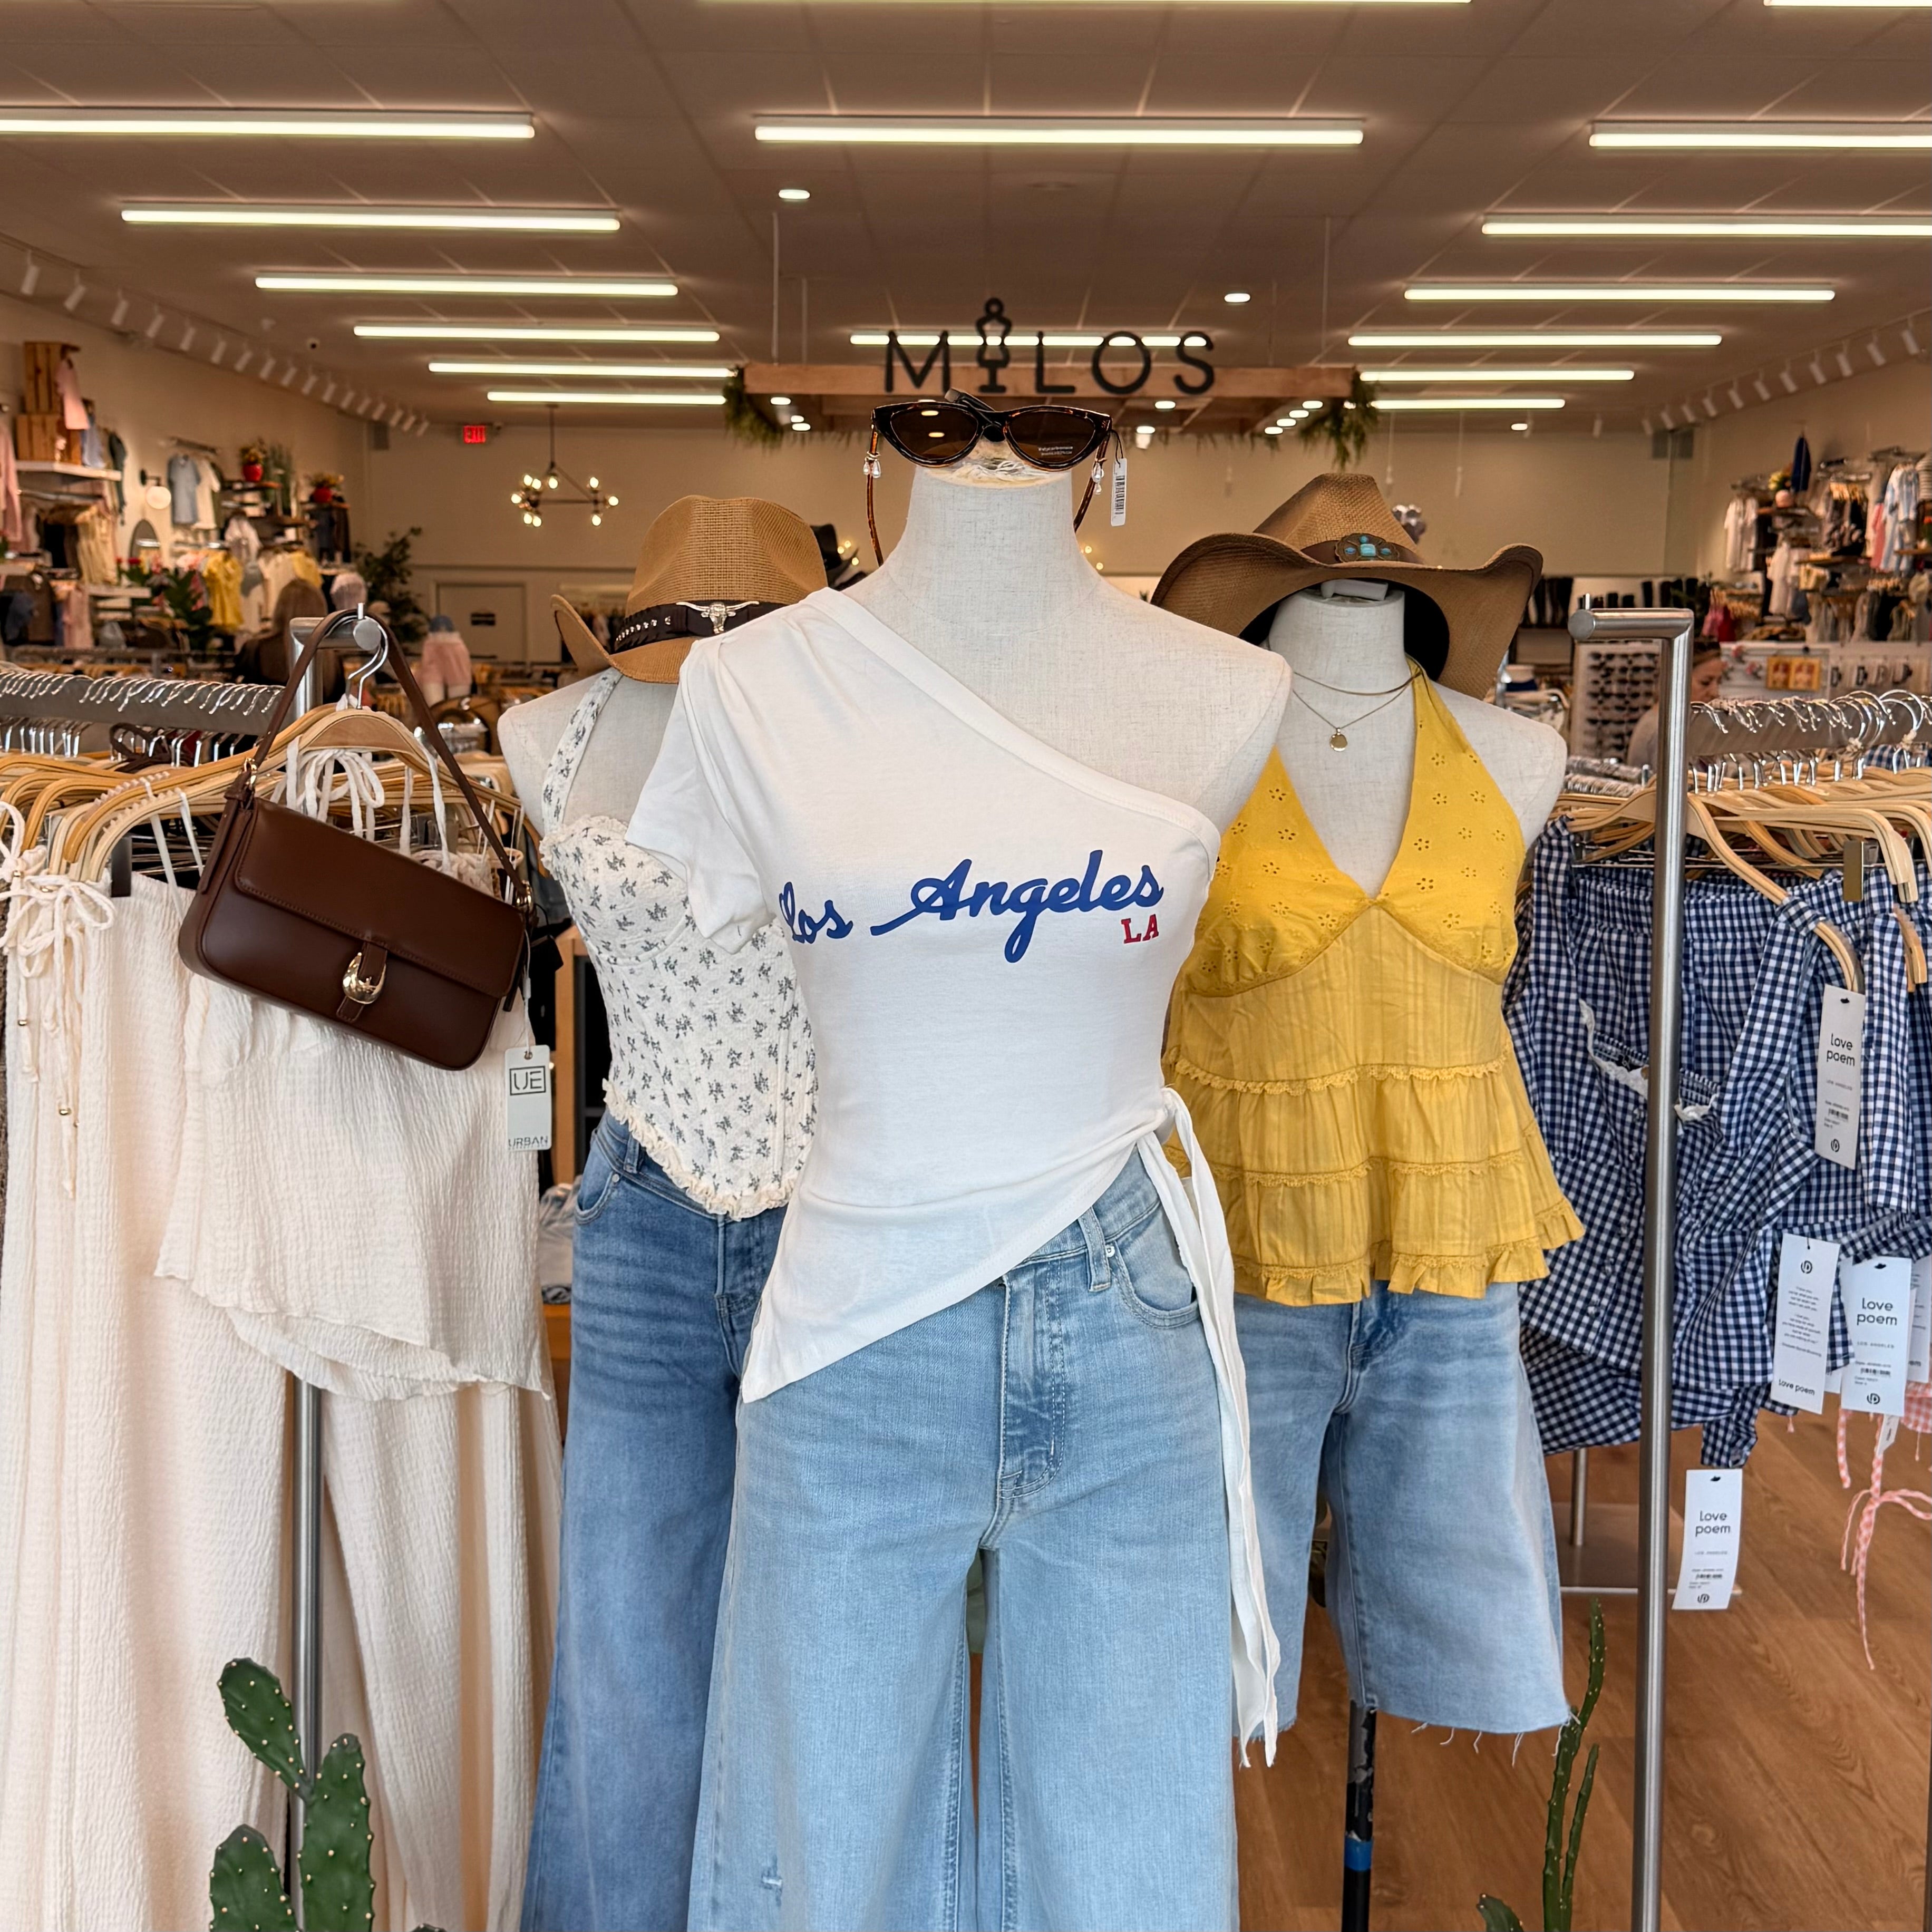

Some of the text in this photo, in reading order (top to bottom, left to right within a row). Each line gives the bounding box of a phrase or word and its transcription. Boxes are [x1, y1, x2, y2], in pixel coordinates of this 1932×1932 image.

[885, 297, 1215, 395] MILOS
[870, 849, 1163, 963] Angeles
[1121, 914, 1159, 944] LA
[1826, 1050, 1855, 1066] poem
[513, 1071, 542, 1090] UE
[508, 1136, 548, 1147] URBAN
[1857, 1314, 1898, 1326] poem
[1695, 1525, 1731, 1537] poem
